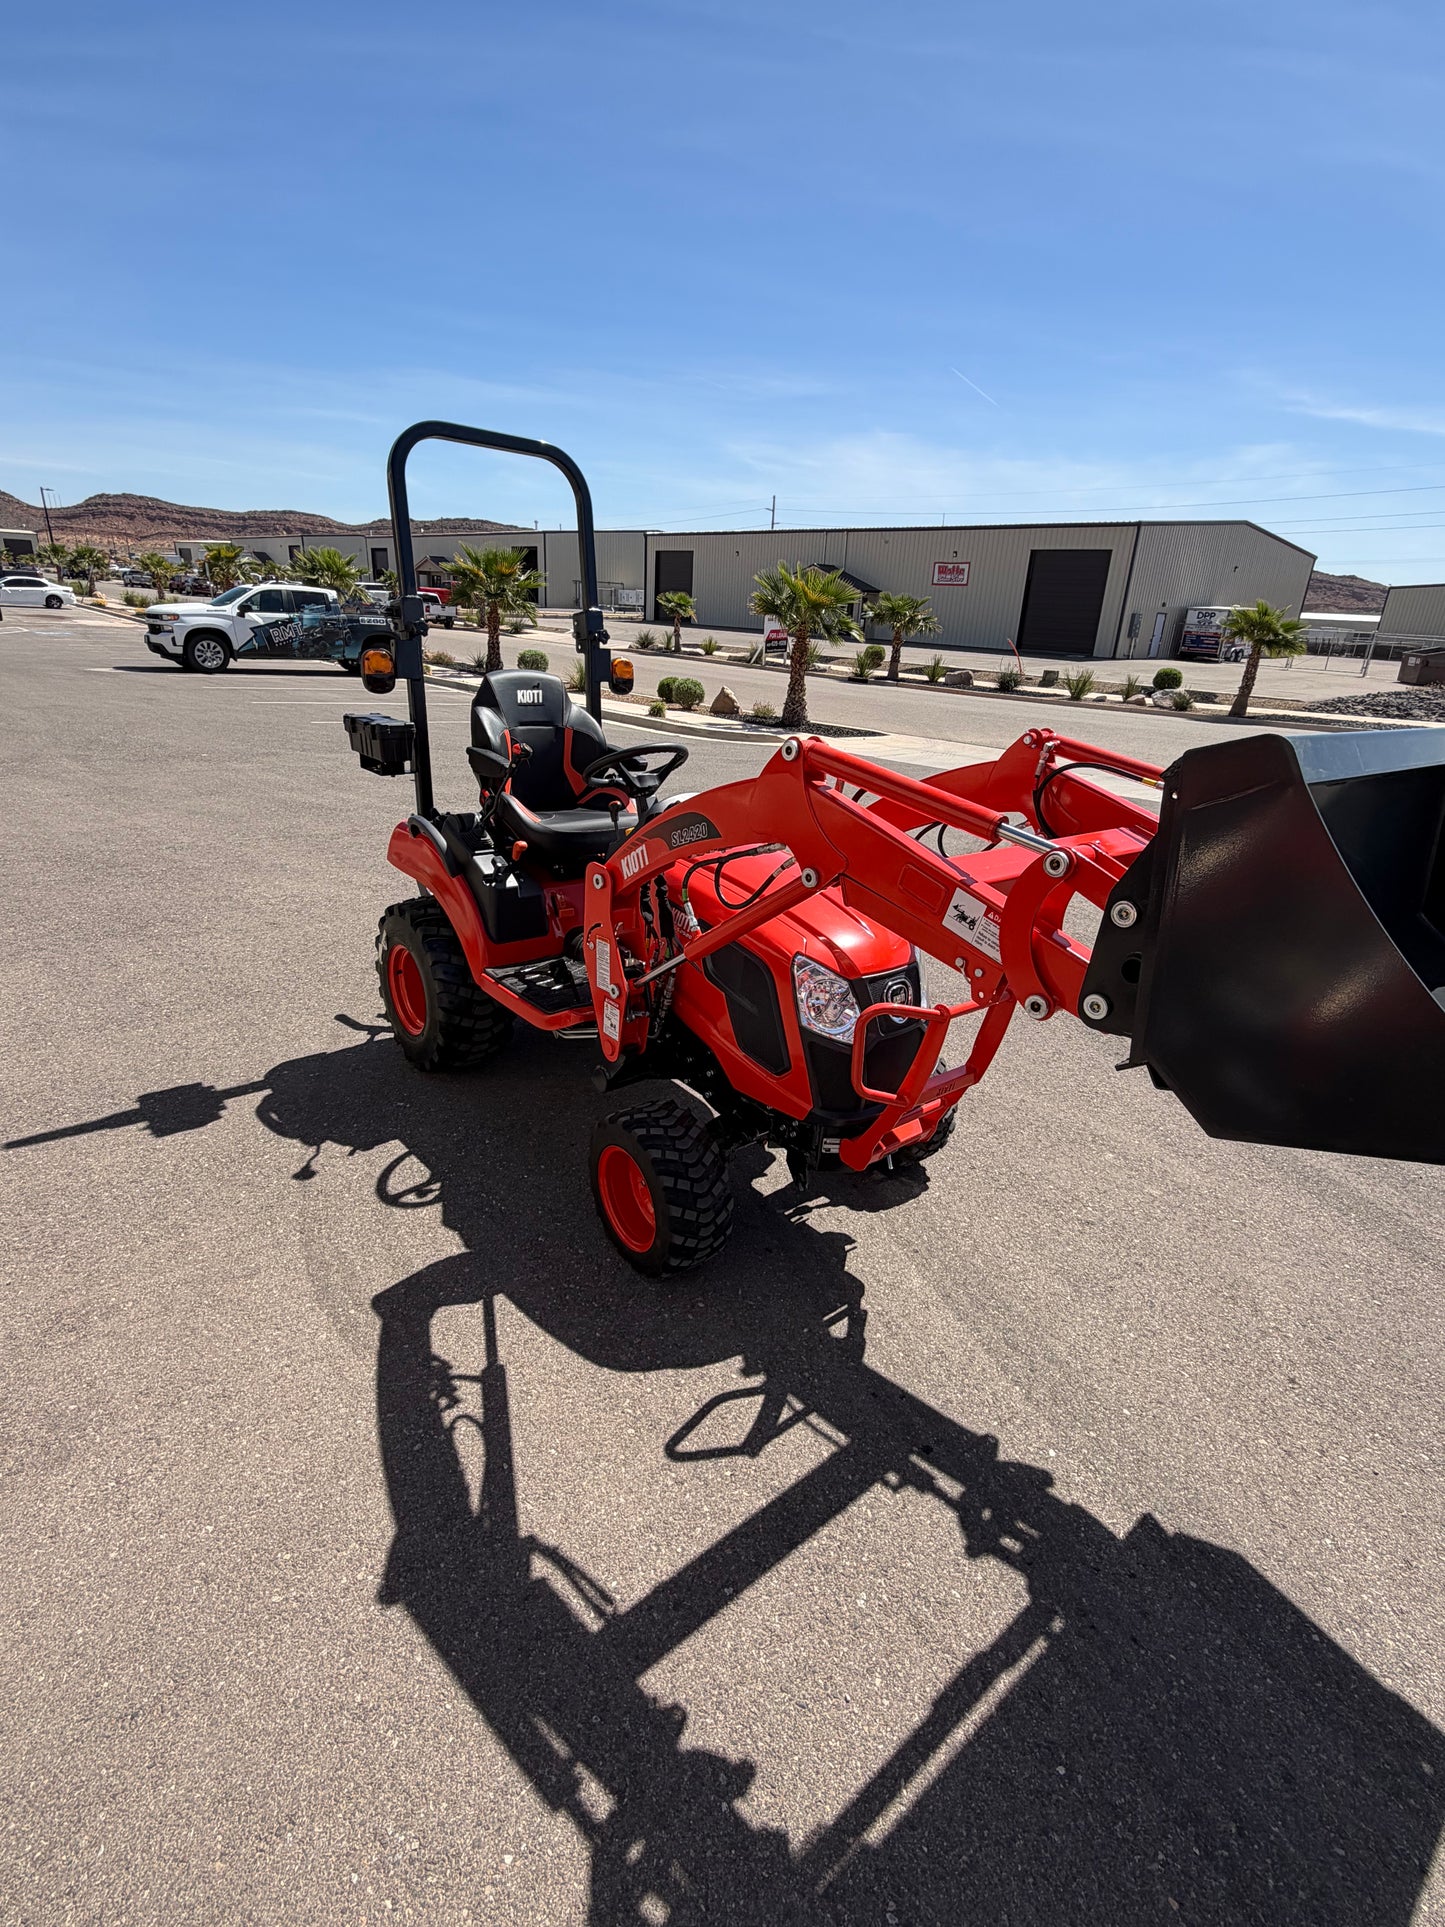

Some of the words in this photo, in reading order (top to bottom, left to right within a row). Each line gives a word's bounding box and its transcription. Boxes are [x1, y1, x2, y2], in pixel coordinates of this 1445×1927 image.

[1197, 611, 1216, 620] DPP
[270, 621, 303, 643] RMT
[517, 689, 543, 703] KIOTI
[671, 822, 708, 847] SL2420
[621, 843, 649, 880] KIOTI
